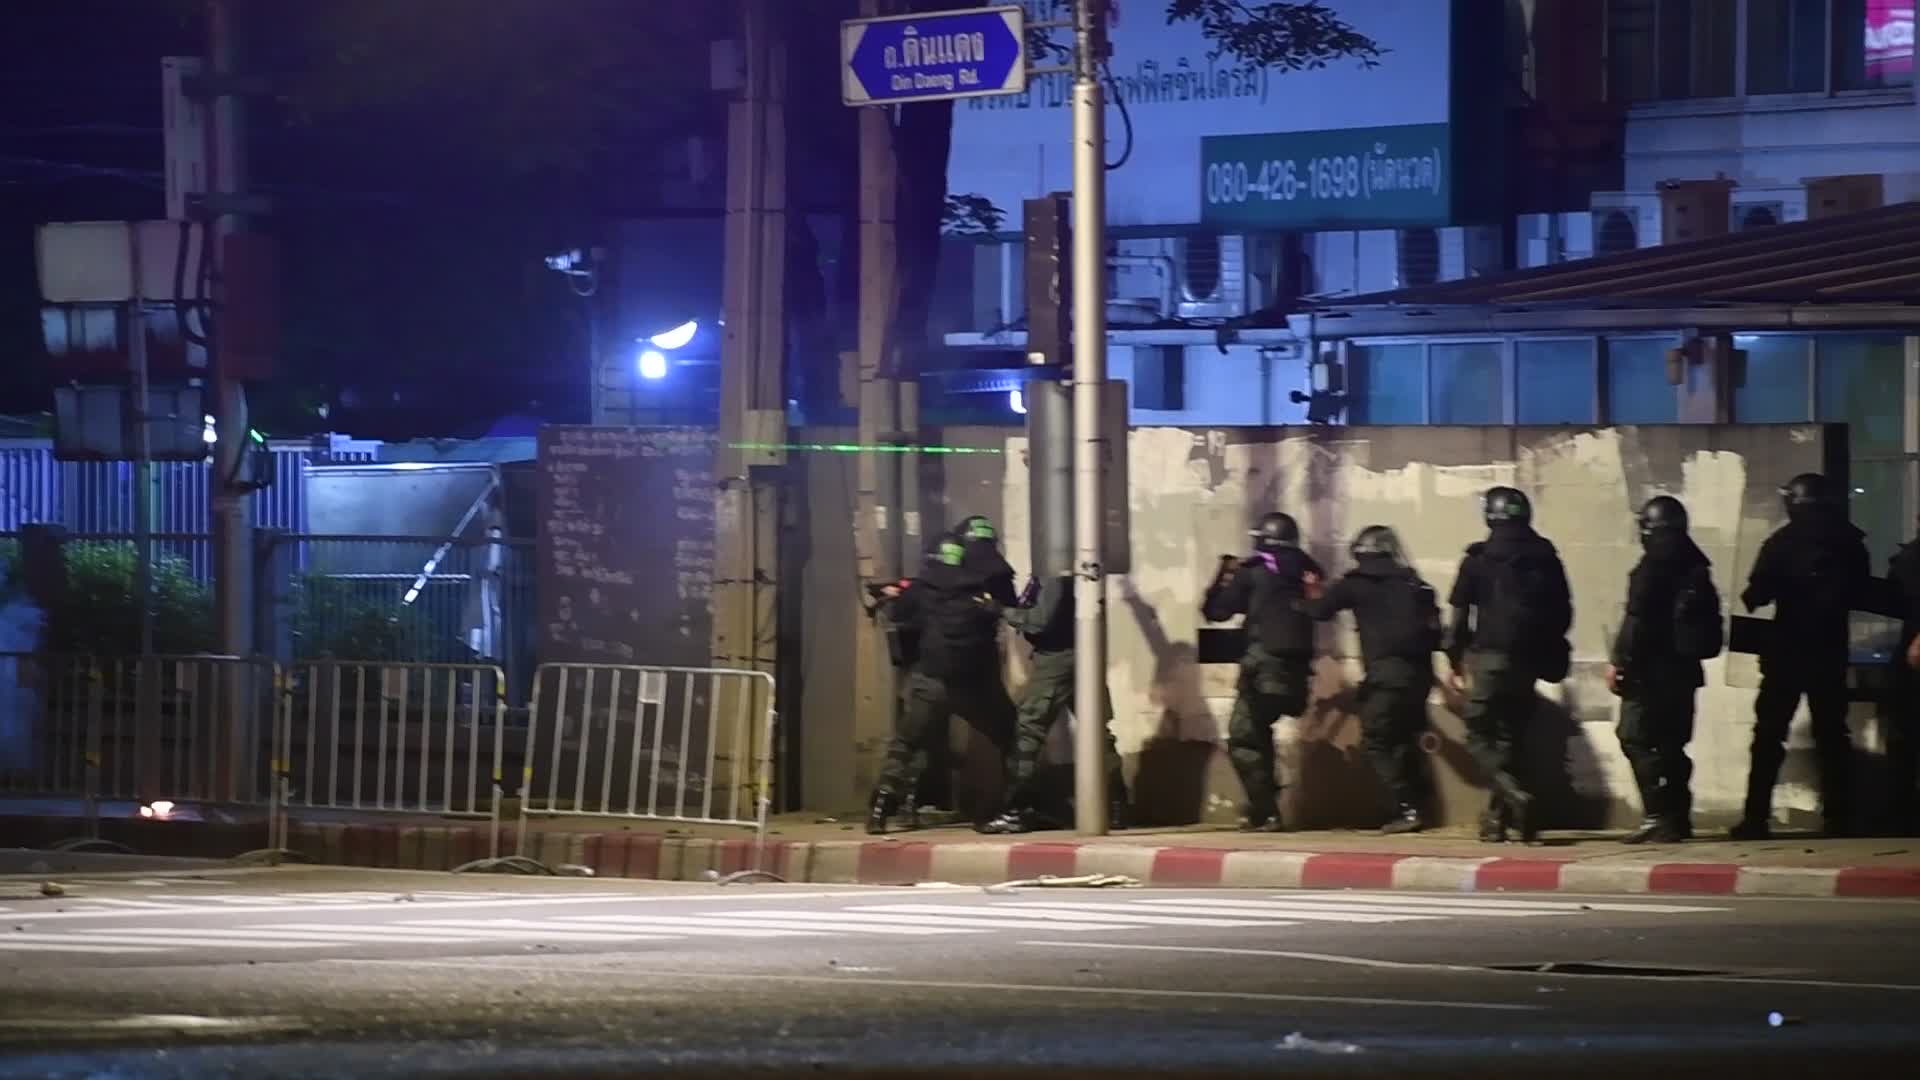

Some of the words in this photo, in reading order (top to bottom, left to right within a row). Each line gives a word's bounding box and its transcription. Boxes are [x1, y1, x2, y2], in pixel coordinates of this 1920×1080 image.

[883, 25, 985, 69] ถ.ดินแดง
[891, 74, 913, 91] Din
[914, 72, 955, 90] Daeng
